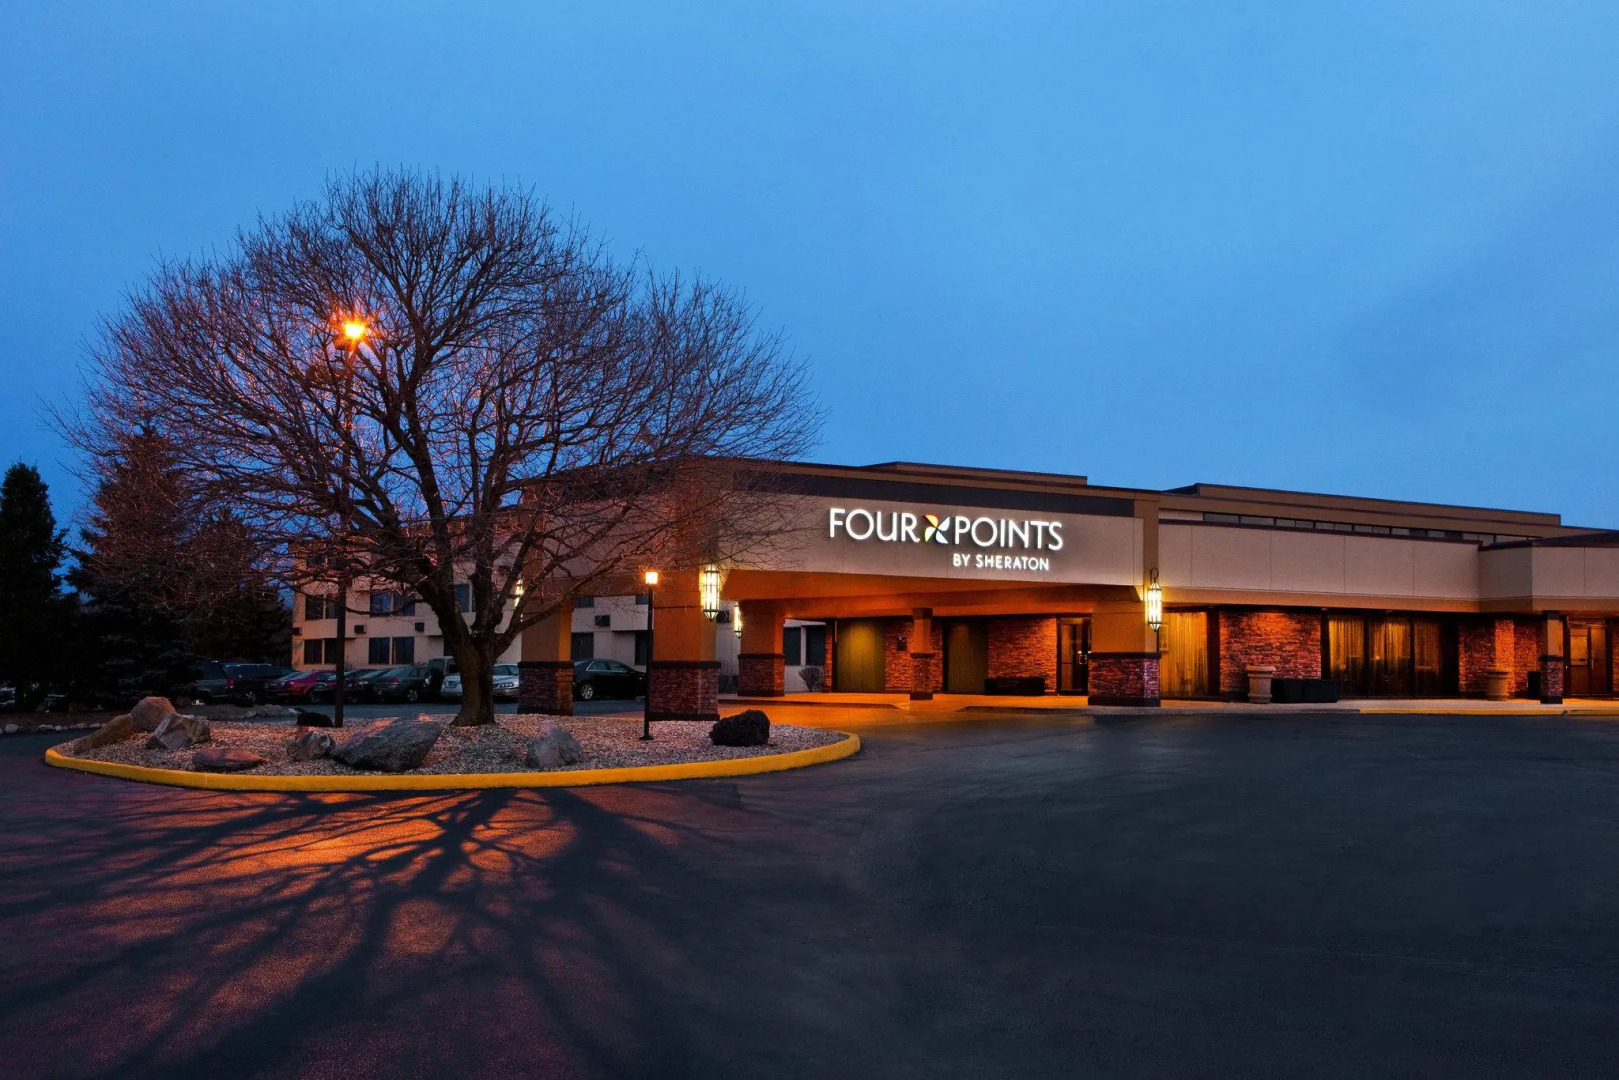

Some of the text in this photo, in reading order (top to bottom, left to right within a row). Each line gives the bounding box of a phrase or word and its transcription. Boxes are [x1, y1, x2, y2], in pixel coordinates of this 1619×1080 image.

[829, 507, 1063, 551] FOUR POINTS
[952, 553, 1050, 571] BY SHERATON
